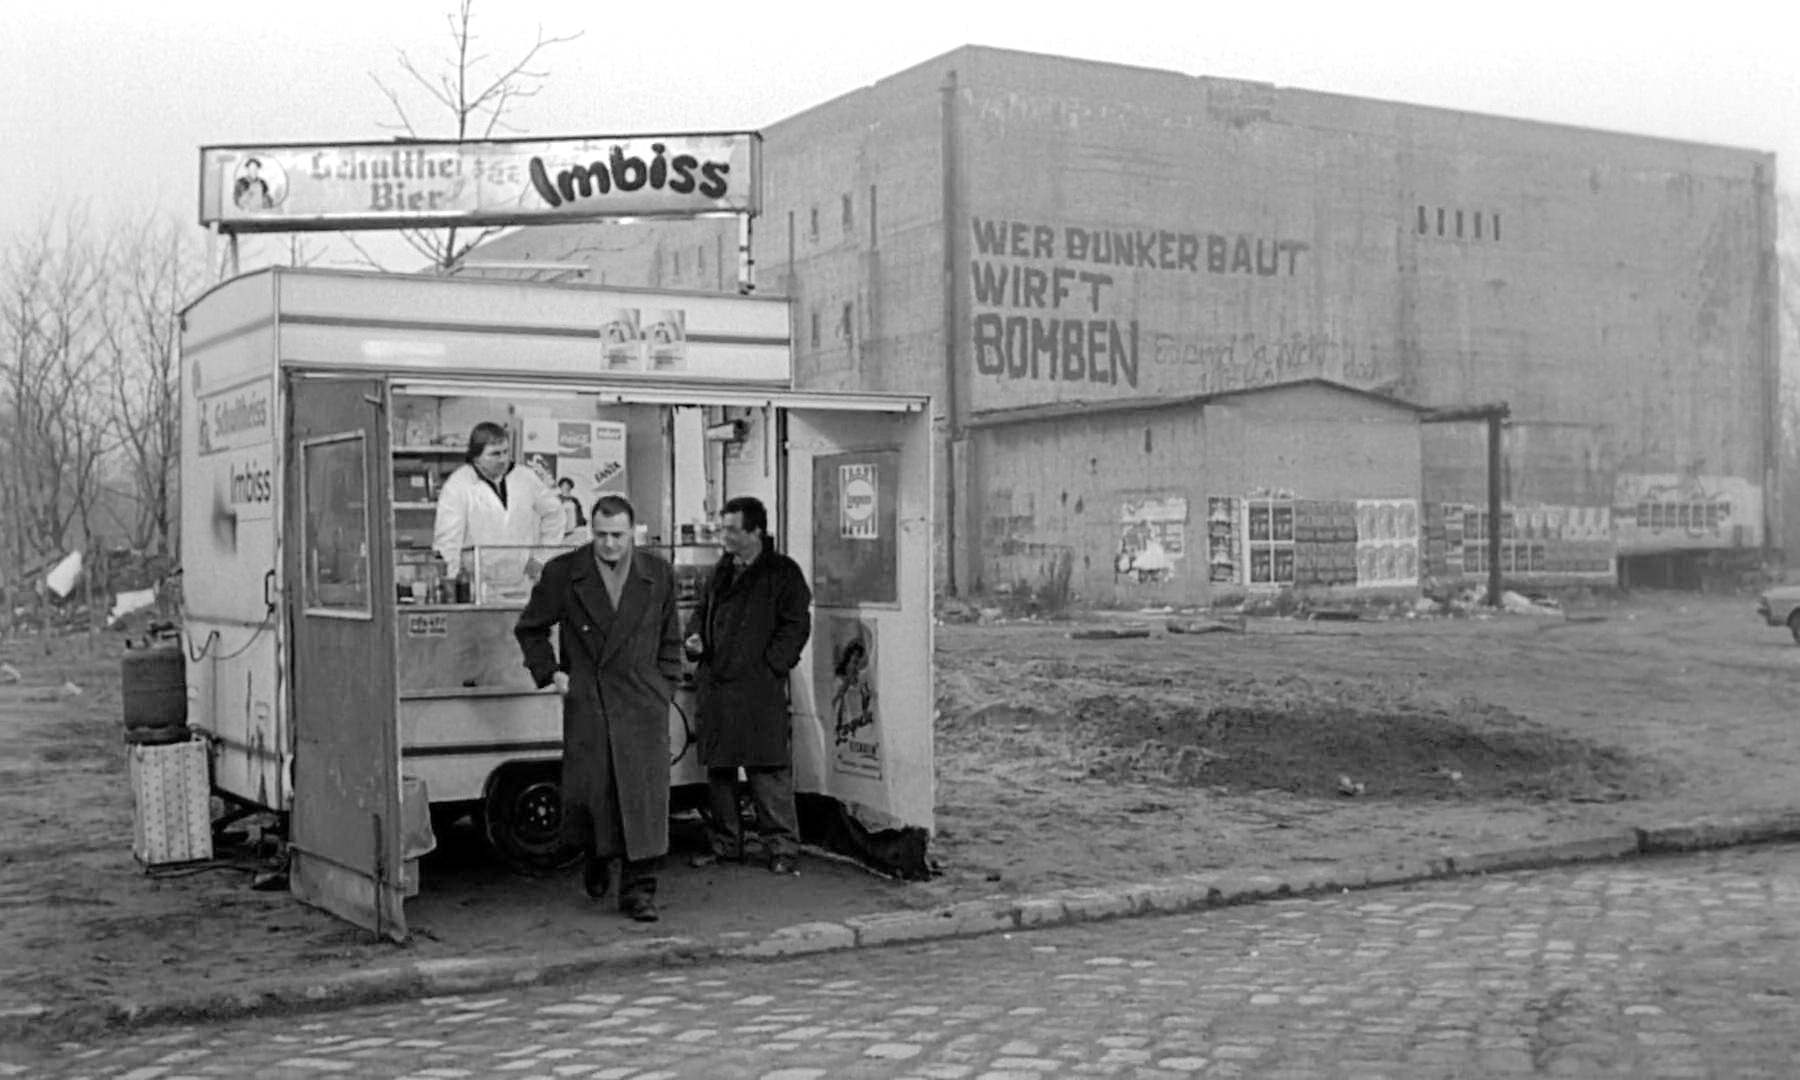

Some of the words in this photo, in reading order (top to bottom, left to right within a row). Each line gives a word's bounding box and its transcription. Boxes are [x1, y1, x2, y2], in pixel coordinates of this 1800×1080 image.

[370, 181, 444, 211] Bier
[530, 144, 730, 207] Imbiss
[972, 216, 1054, 260] WER
[1064, 226, 1198, 272] BUNKER
[1206, 234, 1309, 277] BAUT
[972, 260, 1113, 313] WIRFT
[973, 312, 1139, 389] BOMBEN
